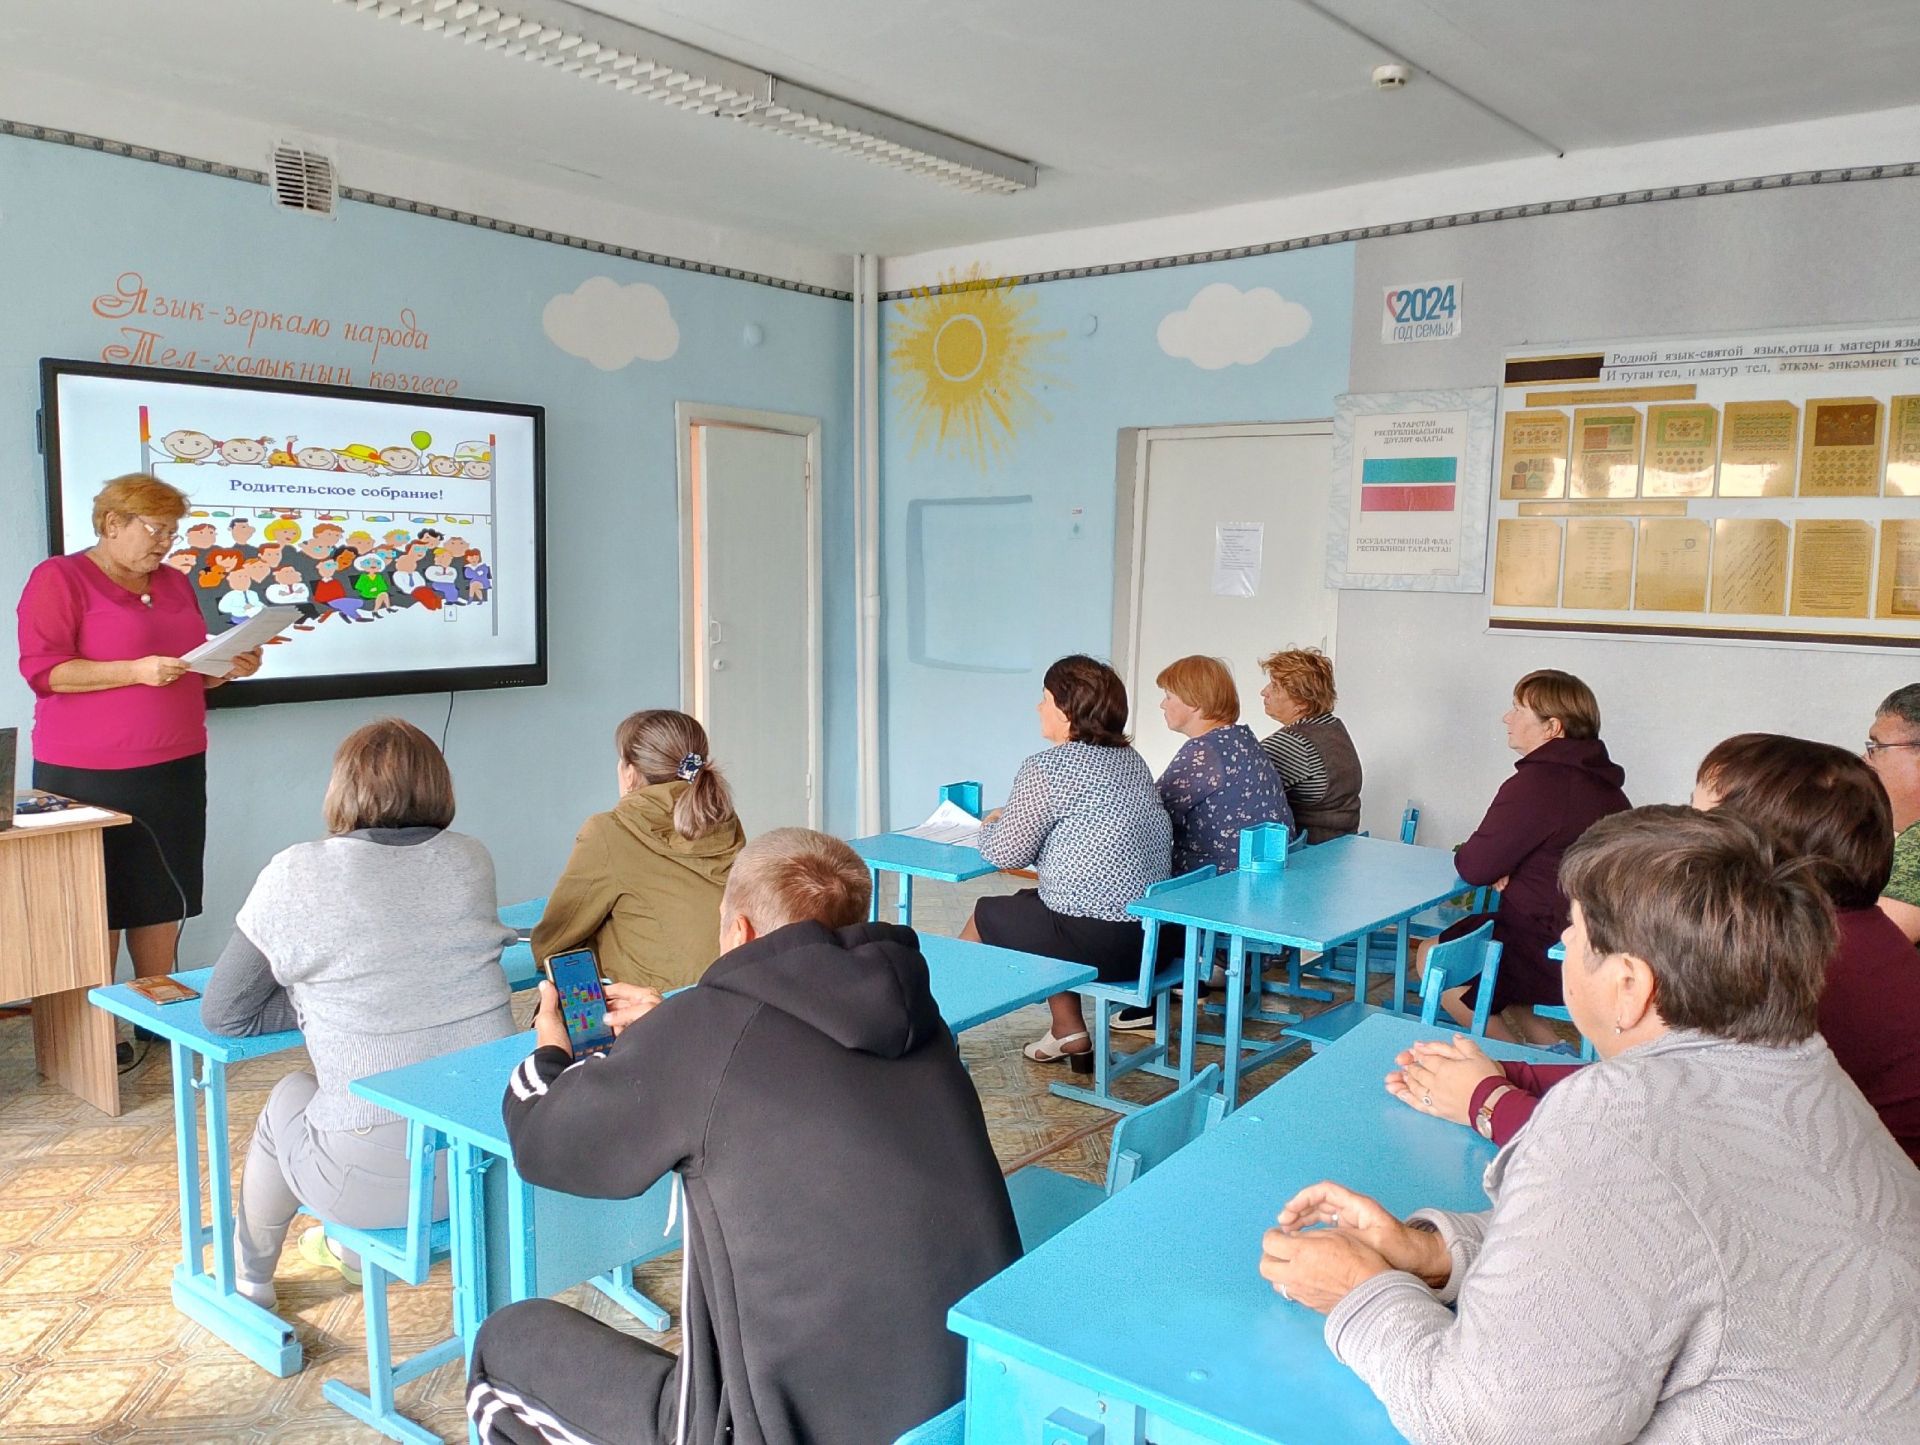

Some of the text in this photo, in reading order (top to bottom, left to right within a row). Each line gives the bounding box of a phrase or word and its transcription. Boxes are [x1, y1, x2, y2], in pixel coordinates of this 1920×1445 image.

[1396, 285, 1456, 323] 2024
[344, 308, 430, 365] народа
[1613, 352, 1657, 364] Родной
[1824, 343, 1833, 352] и
[1840, 339, 1890, 353] матери
[369, 368, 459, 395] көзгесе
[1606, 370, 1616, 381] И
[1621, 369, 1653, 382] туган
[1657, 367, 1681, 379] тел,
[1688, 368, 1696, 377] и
[1700, 365, 1738, 378] матур
[1392, 420, 1436, 428] ТАТАРСТАН
[229, 479, 443, 501] Родительское собрание!
[1408, 545, 1452, 553] ТАТАРСТАН
[1432, 537, 1453, 545] ФЛАГ
